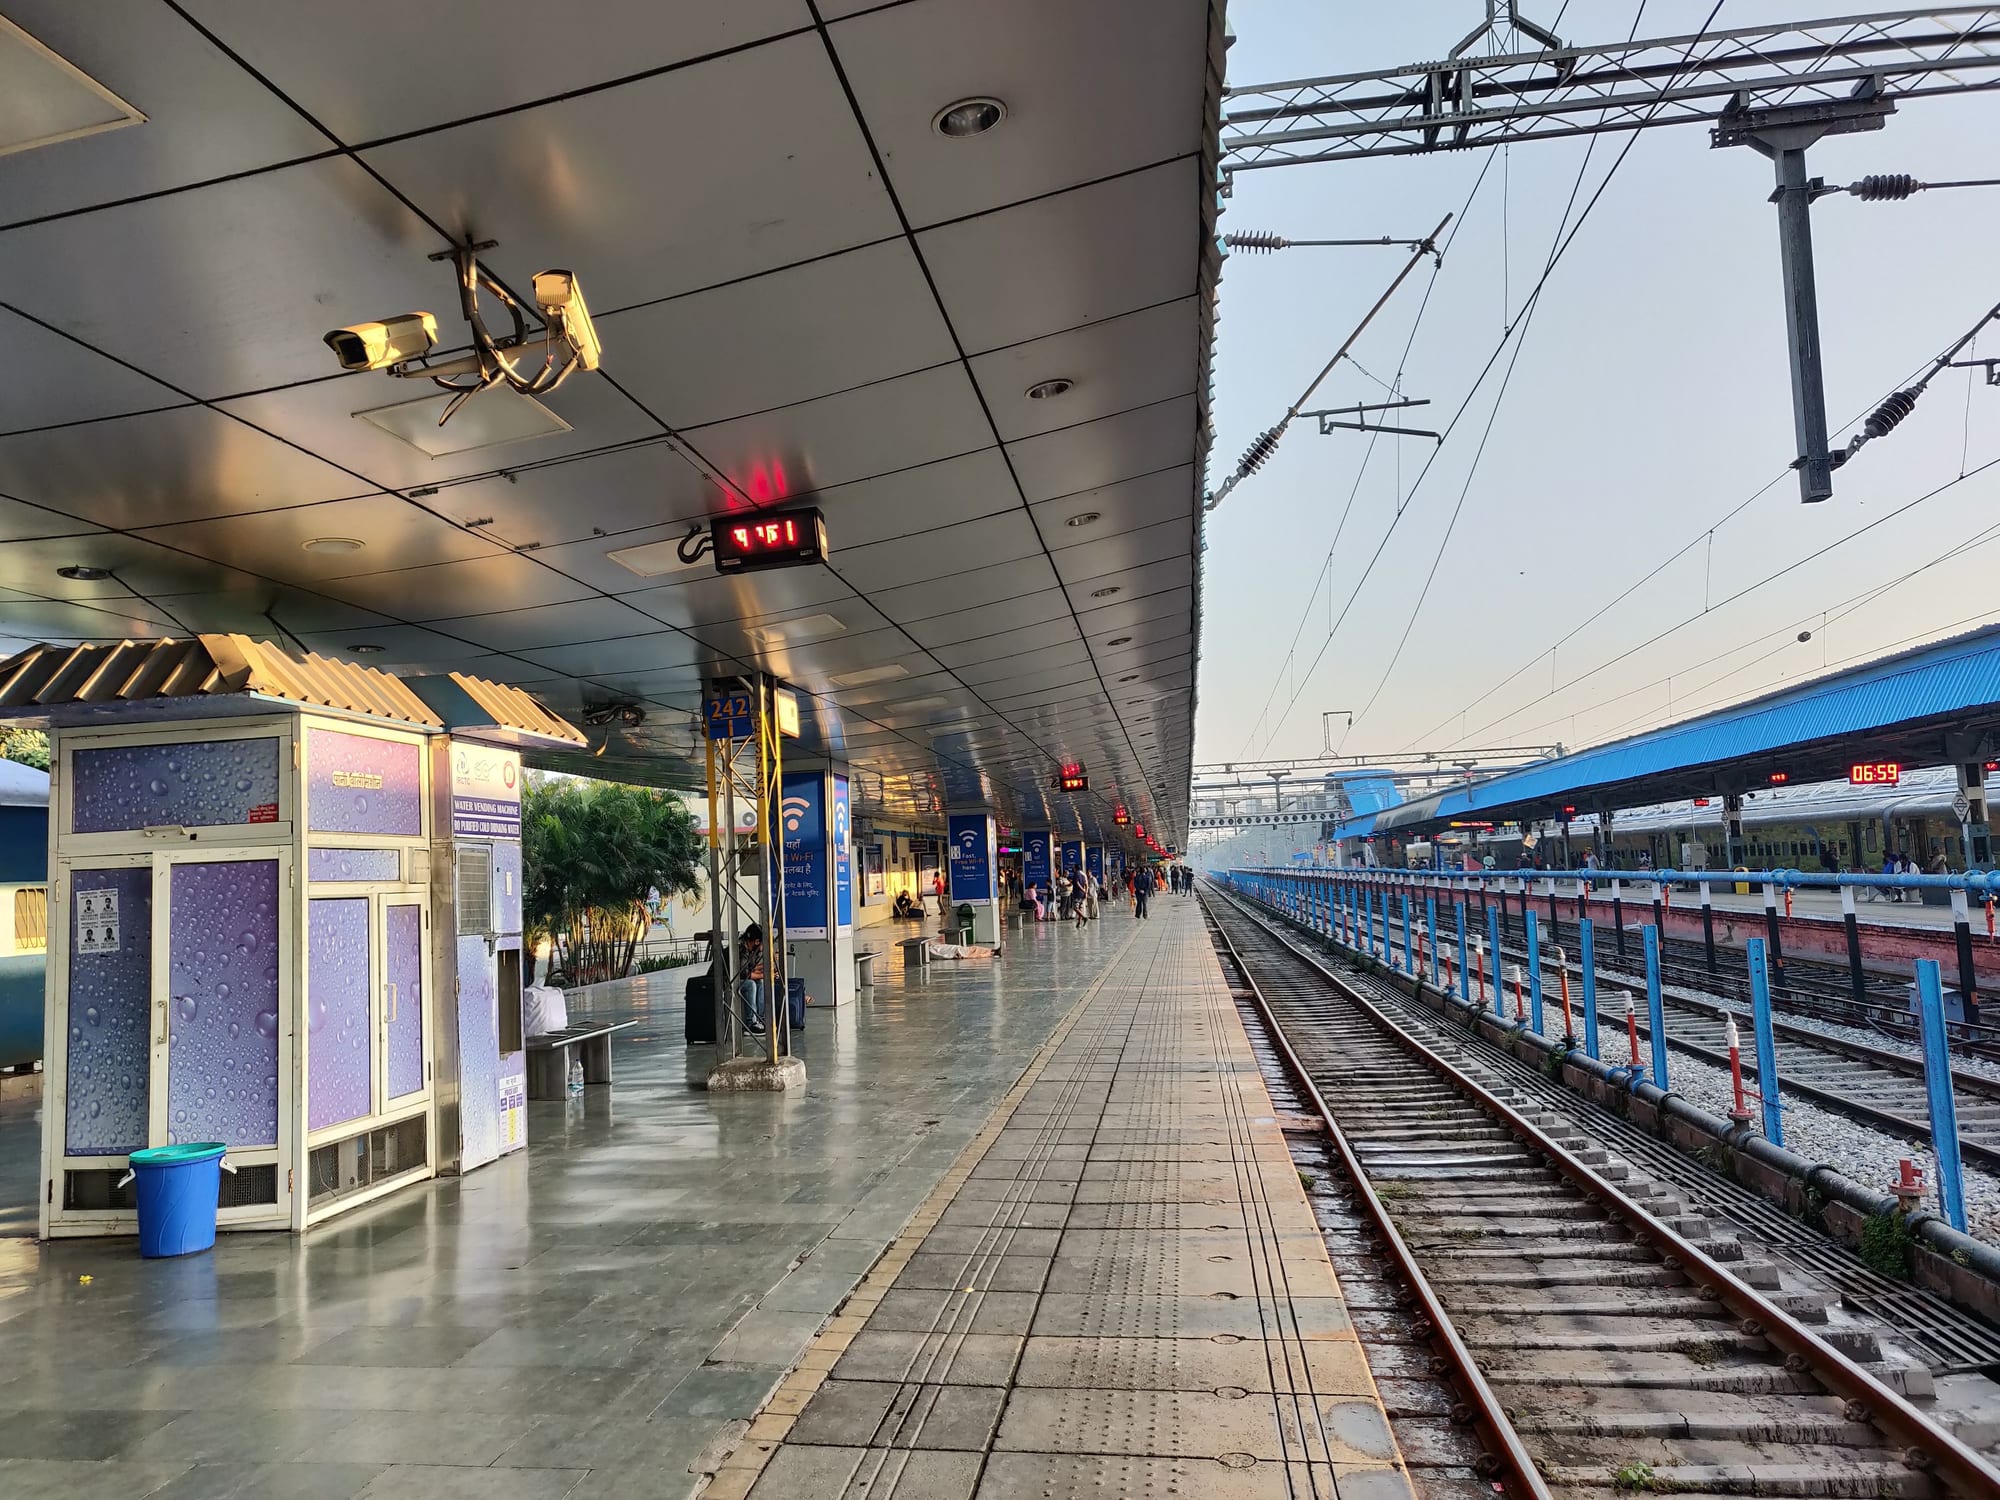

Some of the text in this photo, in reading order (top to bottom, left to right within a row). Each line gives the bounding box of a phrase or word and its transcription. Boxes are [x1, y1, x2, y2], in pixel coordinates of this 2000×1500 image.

[711, 697, 748, 718] 242
[1852, 763, 1898, 782] 06:59
[454, 799, 519, 815] WATER VENDING MACHINE
[460, 820, 479, 832] PURIFIED
[479, 821, 490, 833] COLD
[490, 822, 508, 834] DRINKING
[507, 824, 520, 835] WATER
[791, 851, 814, 862] Wi-Fi
